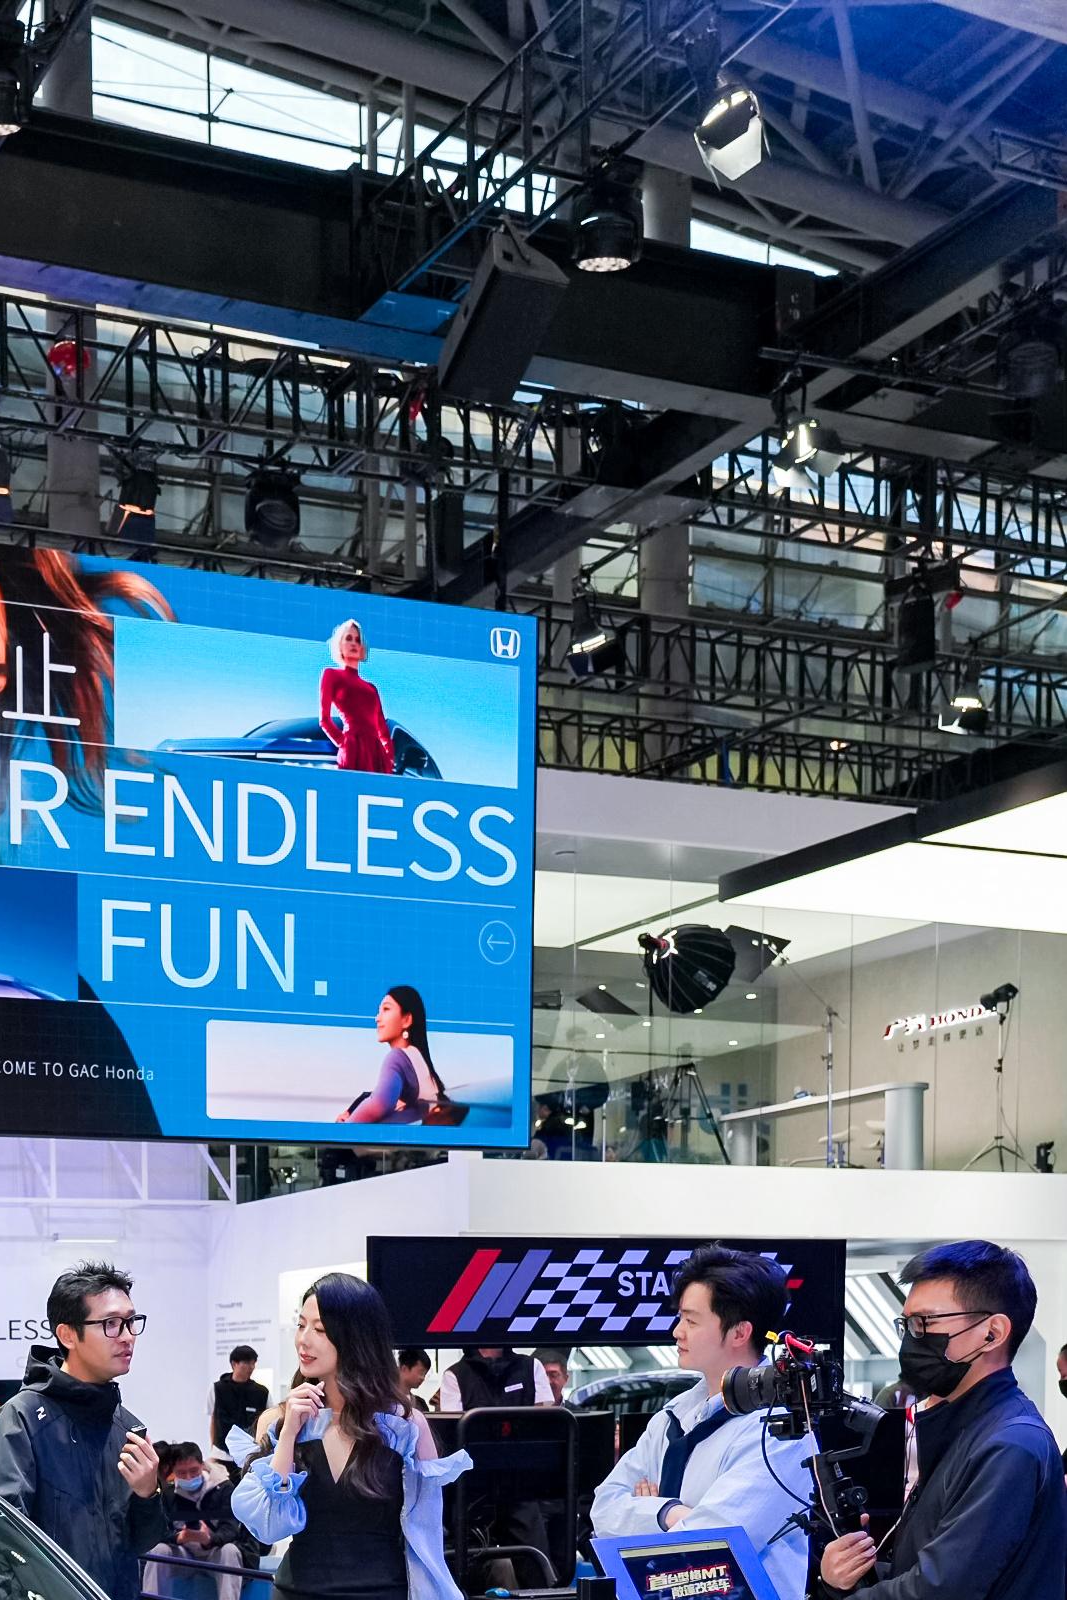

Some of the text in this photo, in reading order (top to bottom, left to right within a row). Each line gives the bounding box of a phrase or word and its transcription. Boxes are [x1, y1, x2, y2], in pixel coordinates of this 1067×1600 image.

[103, 767, 518, 887] ENDLESS
[101, 899, 329, 997] FUN.
[42, 1061, 64, 1077] TO
[68, 1063, 100, 1079] GAC
[105, 1065, 155, 1081] Honda
[617, 1271, 674, 1297] STA
